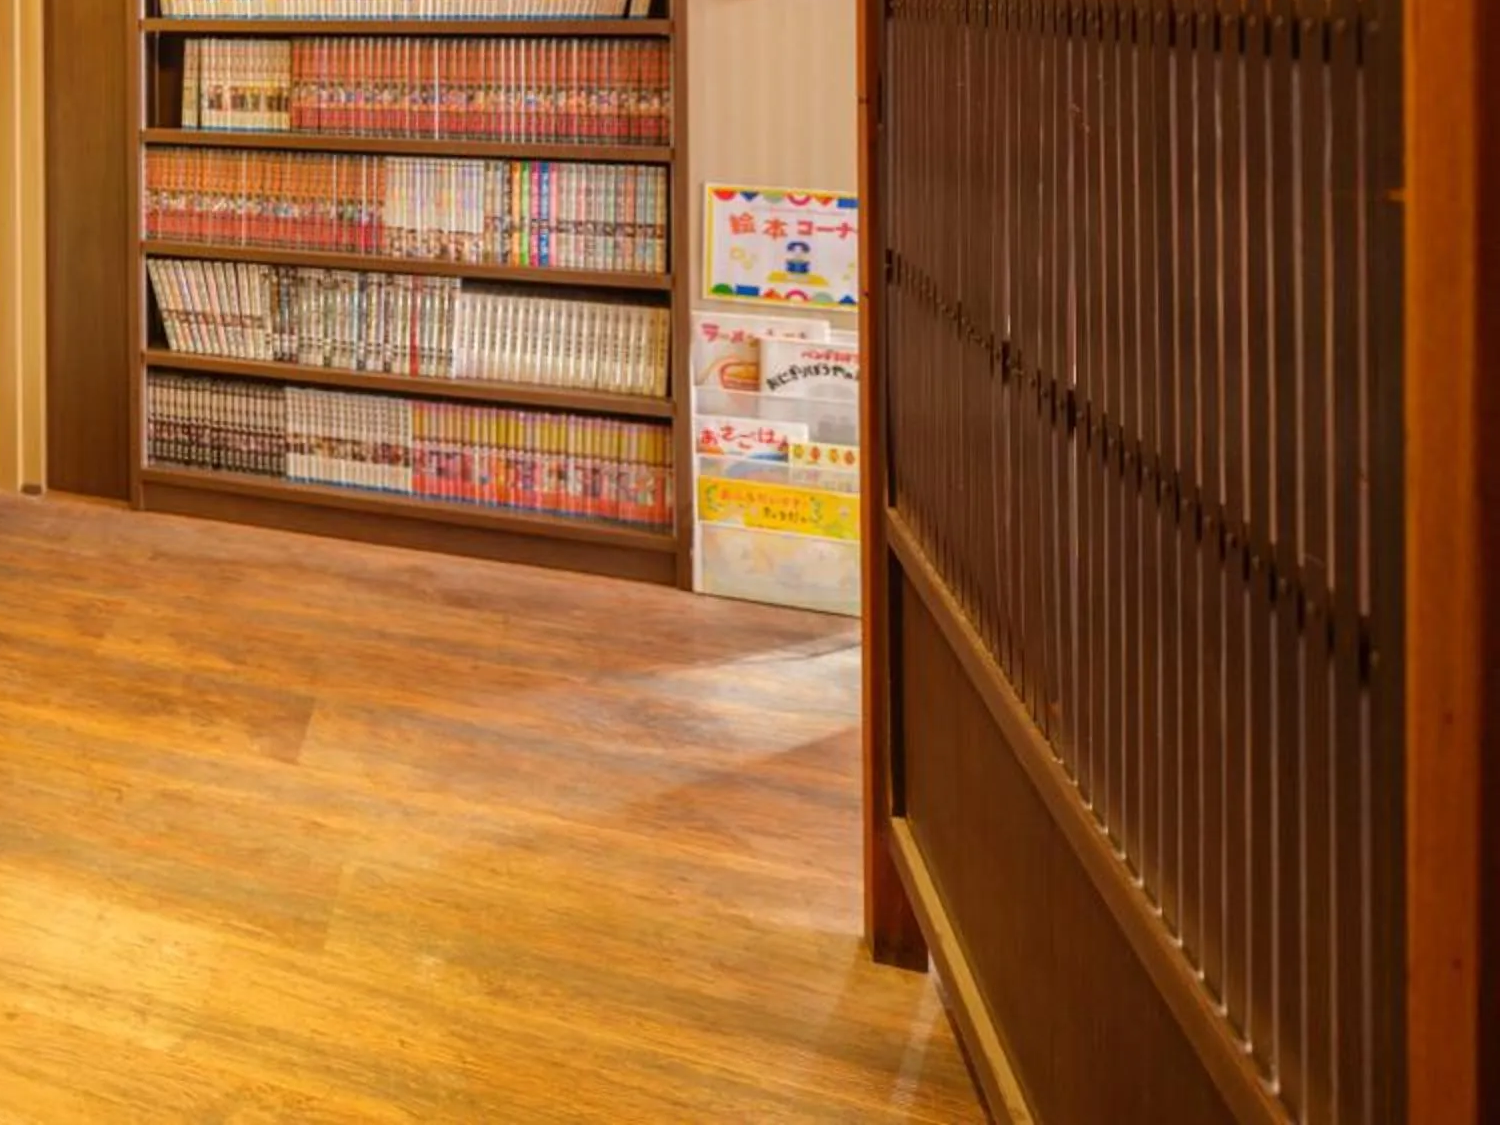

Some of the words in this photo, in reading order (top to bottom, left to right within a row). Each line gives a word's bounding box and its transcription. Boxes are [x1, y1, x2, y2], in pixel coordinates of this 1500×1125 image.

[729, 211, 858, 241] 絵本コーナ
